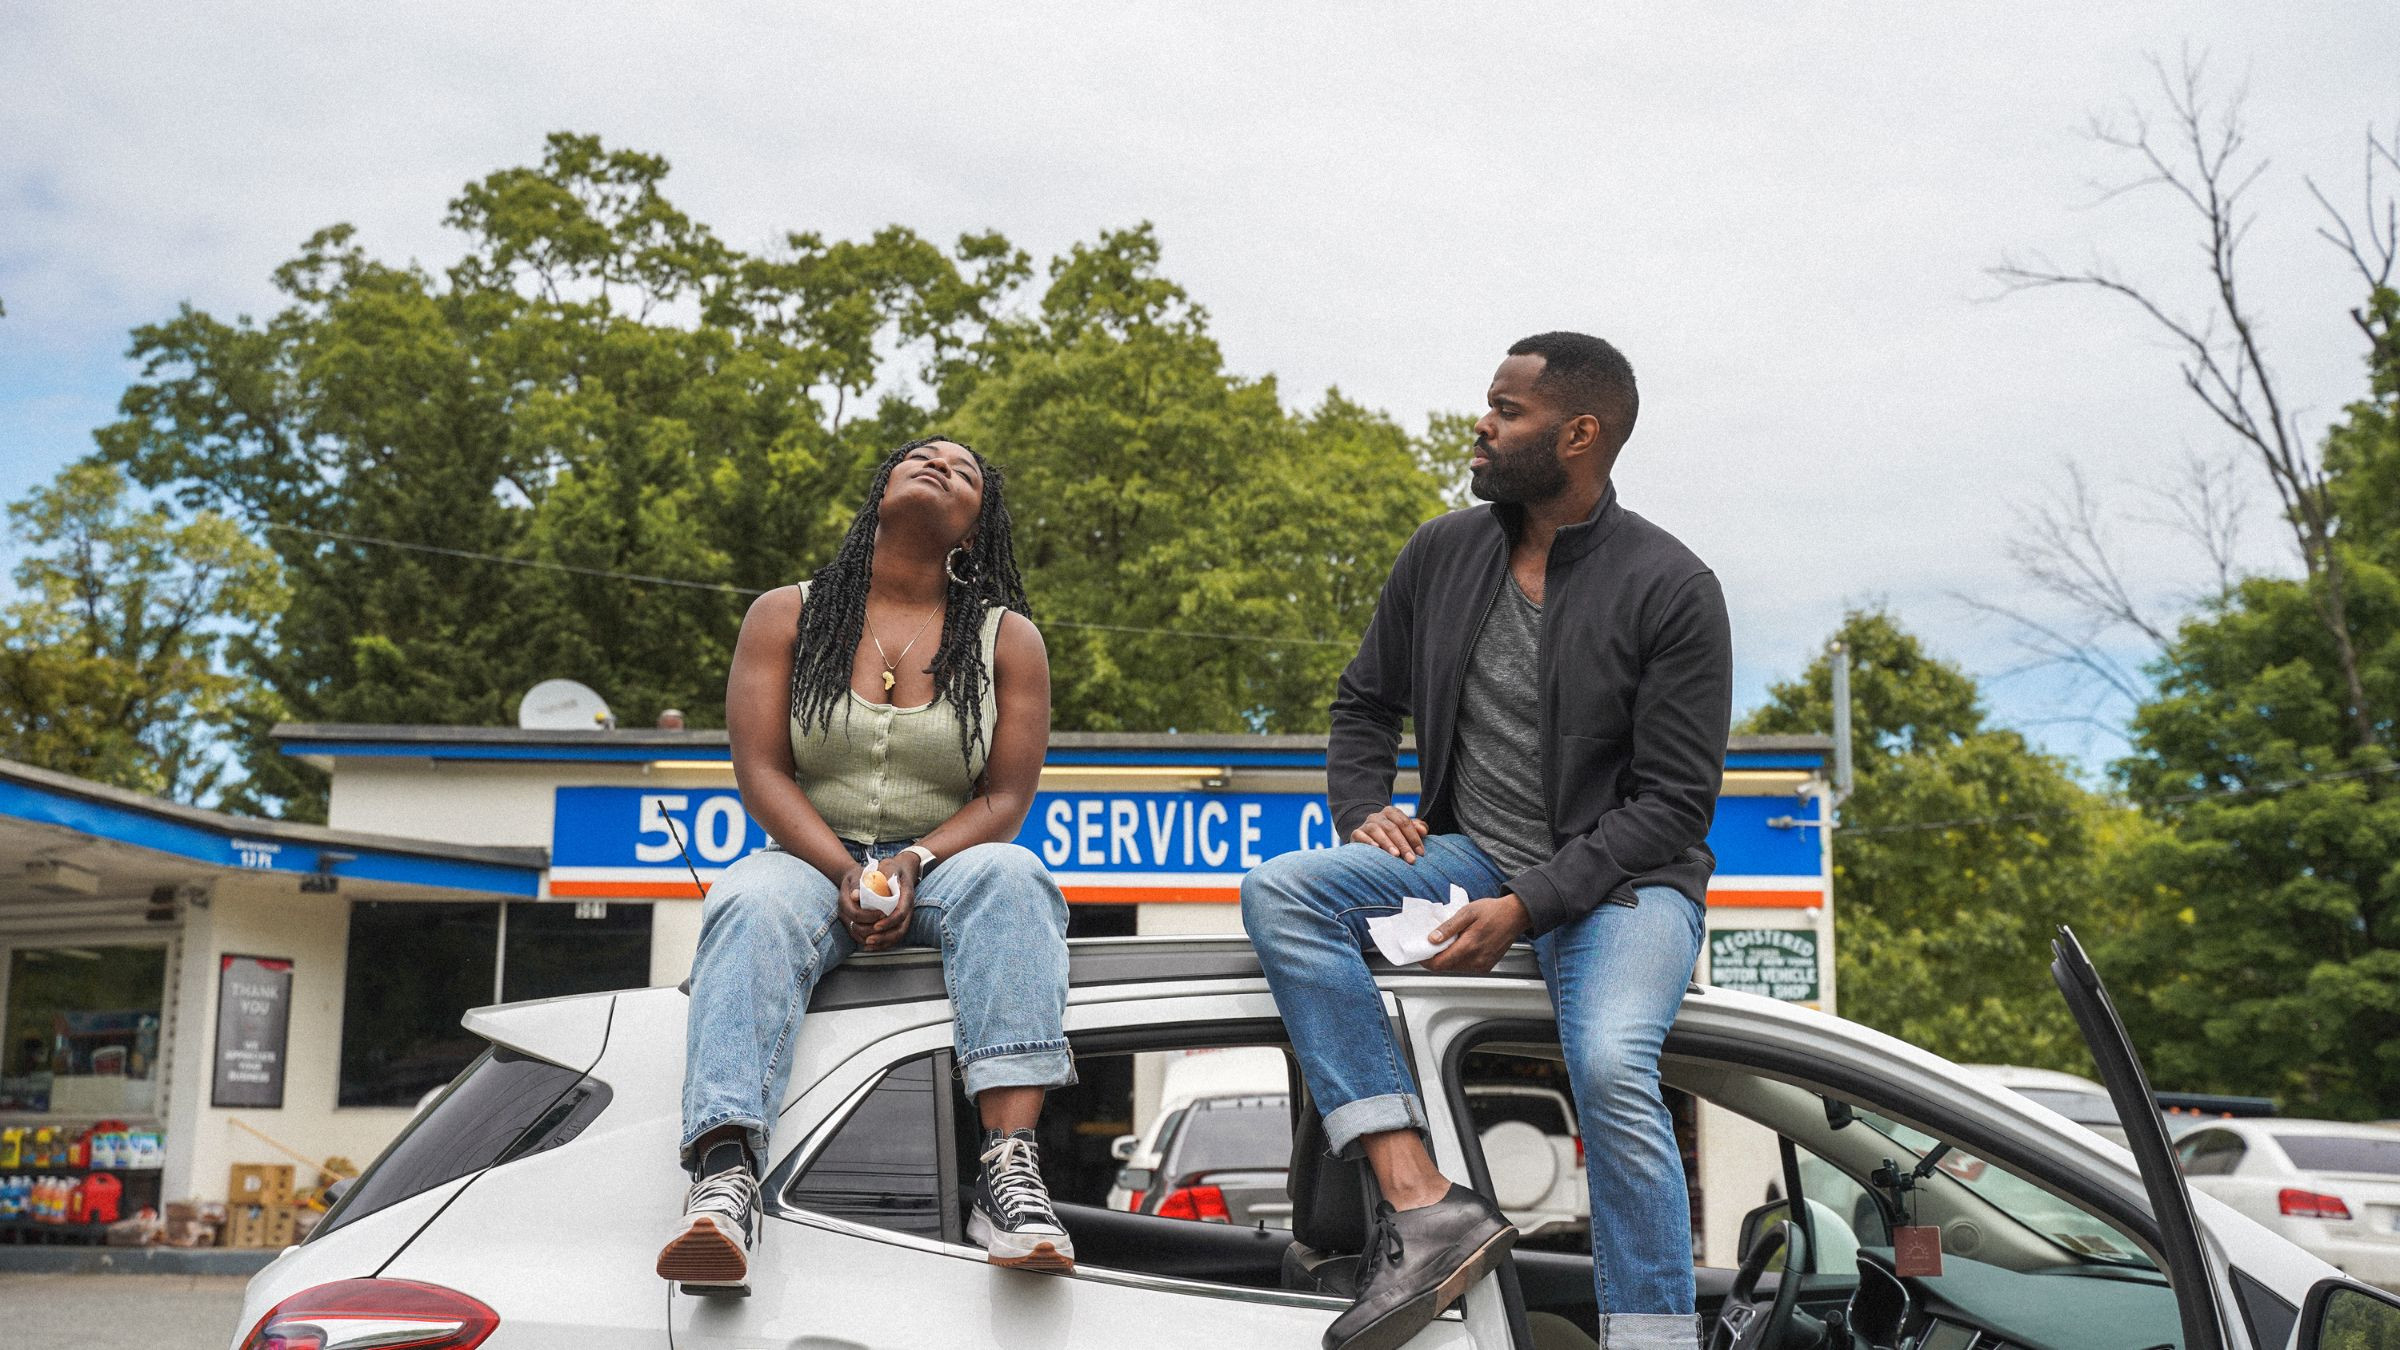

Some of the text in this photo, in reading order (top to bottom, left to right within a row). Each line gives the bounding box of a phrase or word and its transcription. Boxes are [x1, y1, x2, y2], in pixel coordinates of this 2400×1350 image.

[635, 794, 774, 862] 50
[1043, 799, 1263, 868] SERVICE
[1711, 930, 1815, 957] REGISTERED
[1711, 967, 1817, 984] MOTOR VEHICLE
[231, 982, 278, 999] THANK
[1772, 983, 1811, 1000] SHOP
[240, 1000, 271, 1016] YOU
